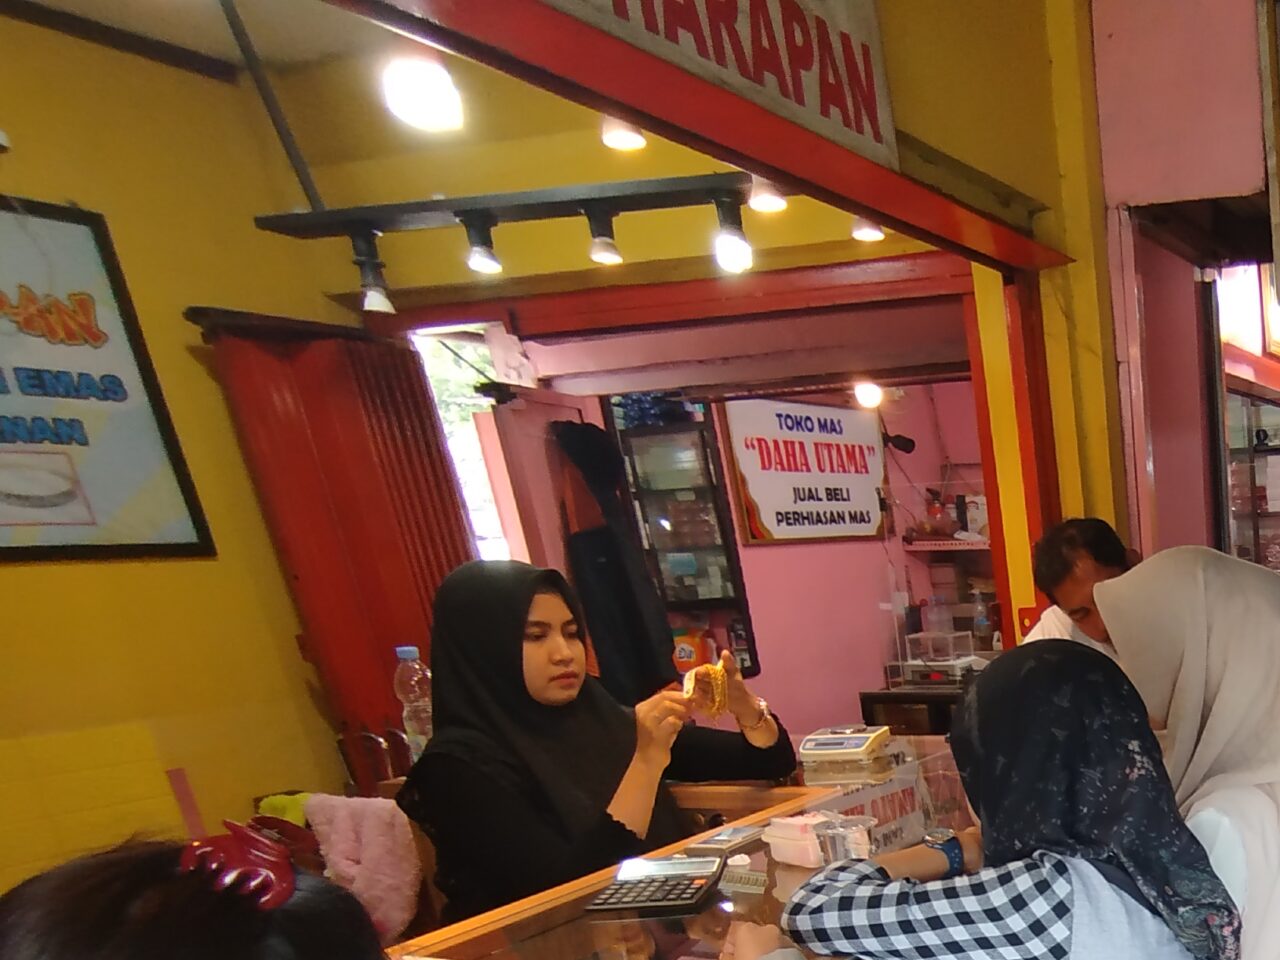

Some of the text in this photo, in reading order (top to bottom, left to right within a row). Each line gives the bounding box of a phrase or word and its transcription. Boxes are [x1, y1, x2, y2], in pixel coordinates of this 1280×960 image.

[612, 0, 883, 144] ARAPAN
[13, 367, 128, 402] EMAS
[775, 413, 843, 435] TOKO MAS
[744, 437, 876, 475] “DAHA UTAMA”
[793, 487, 851, 504] JUAL BELI
[775, 510, 871, 526] PERHIASAN MAS
